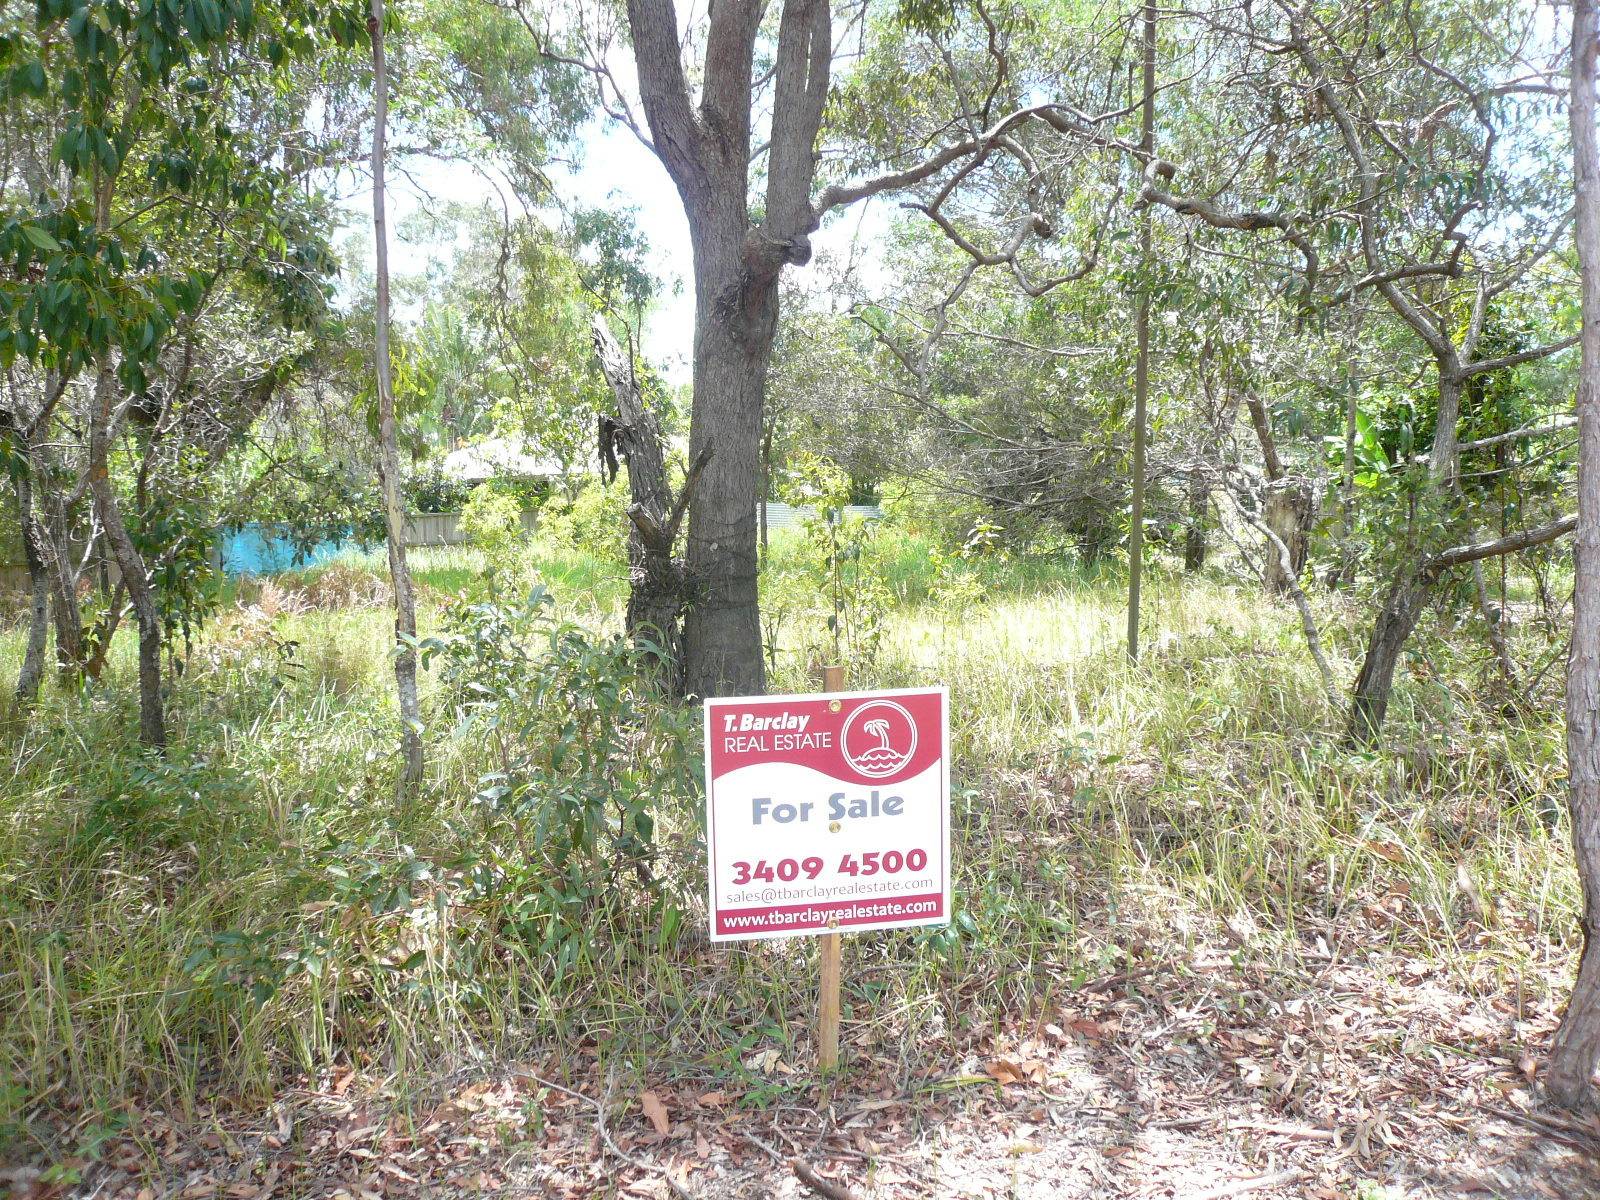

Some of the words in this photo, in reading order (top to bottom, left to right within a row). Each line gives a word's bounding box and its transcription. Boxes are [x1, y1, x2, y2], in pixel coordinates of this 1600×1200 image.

[724, 736, 769, 754] REAL
[774, 732, 832, 751] ESTATE
[752, 797, 814, 825] For
[828, 790, 904, 821] Sale
[731, 856, 824, 885] 3409
[838, 848, 928, 877] 4500
[726, 878, 934, 904] sales@tbarclayrealestate.com
[723, 900, 937, 928] www.tbarclayrealestate.com
